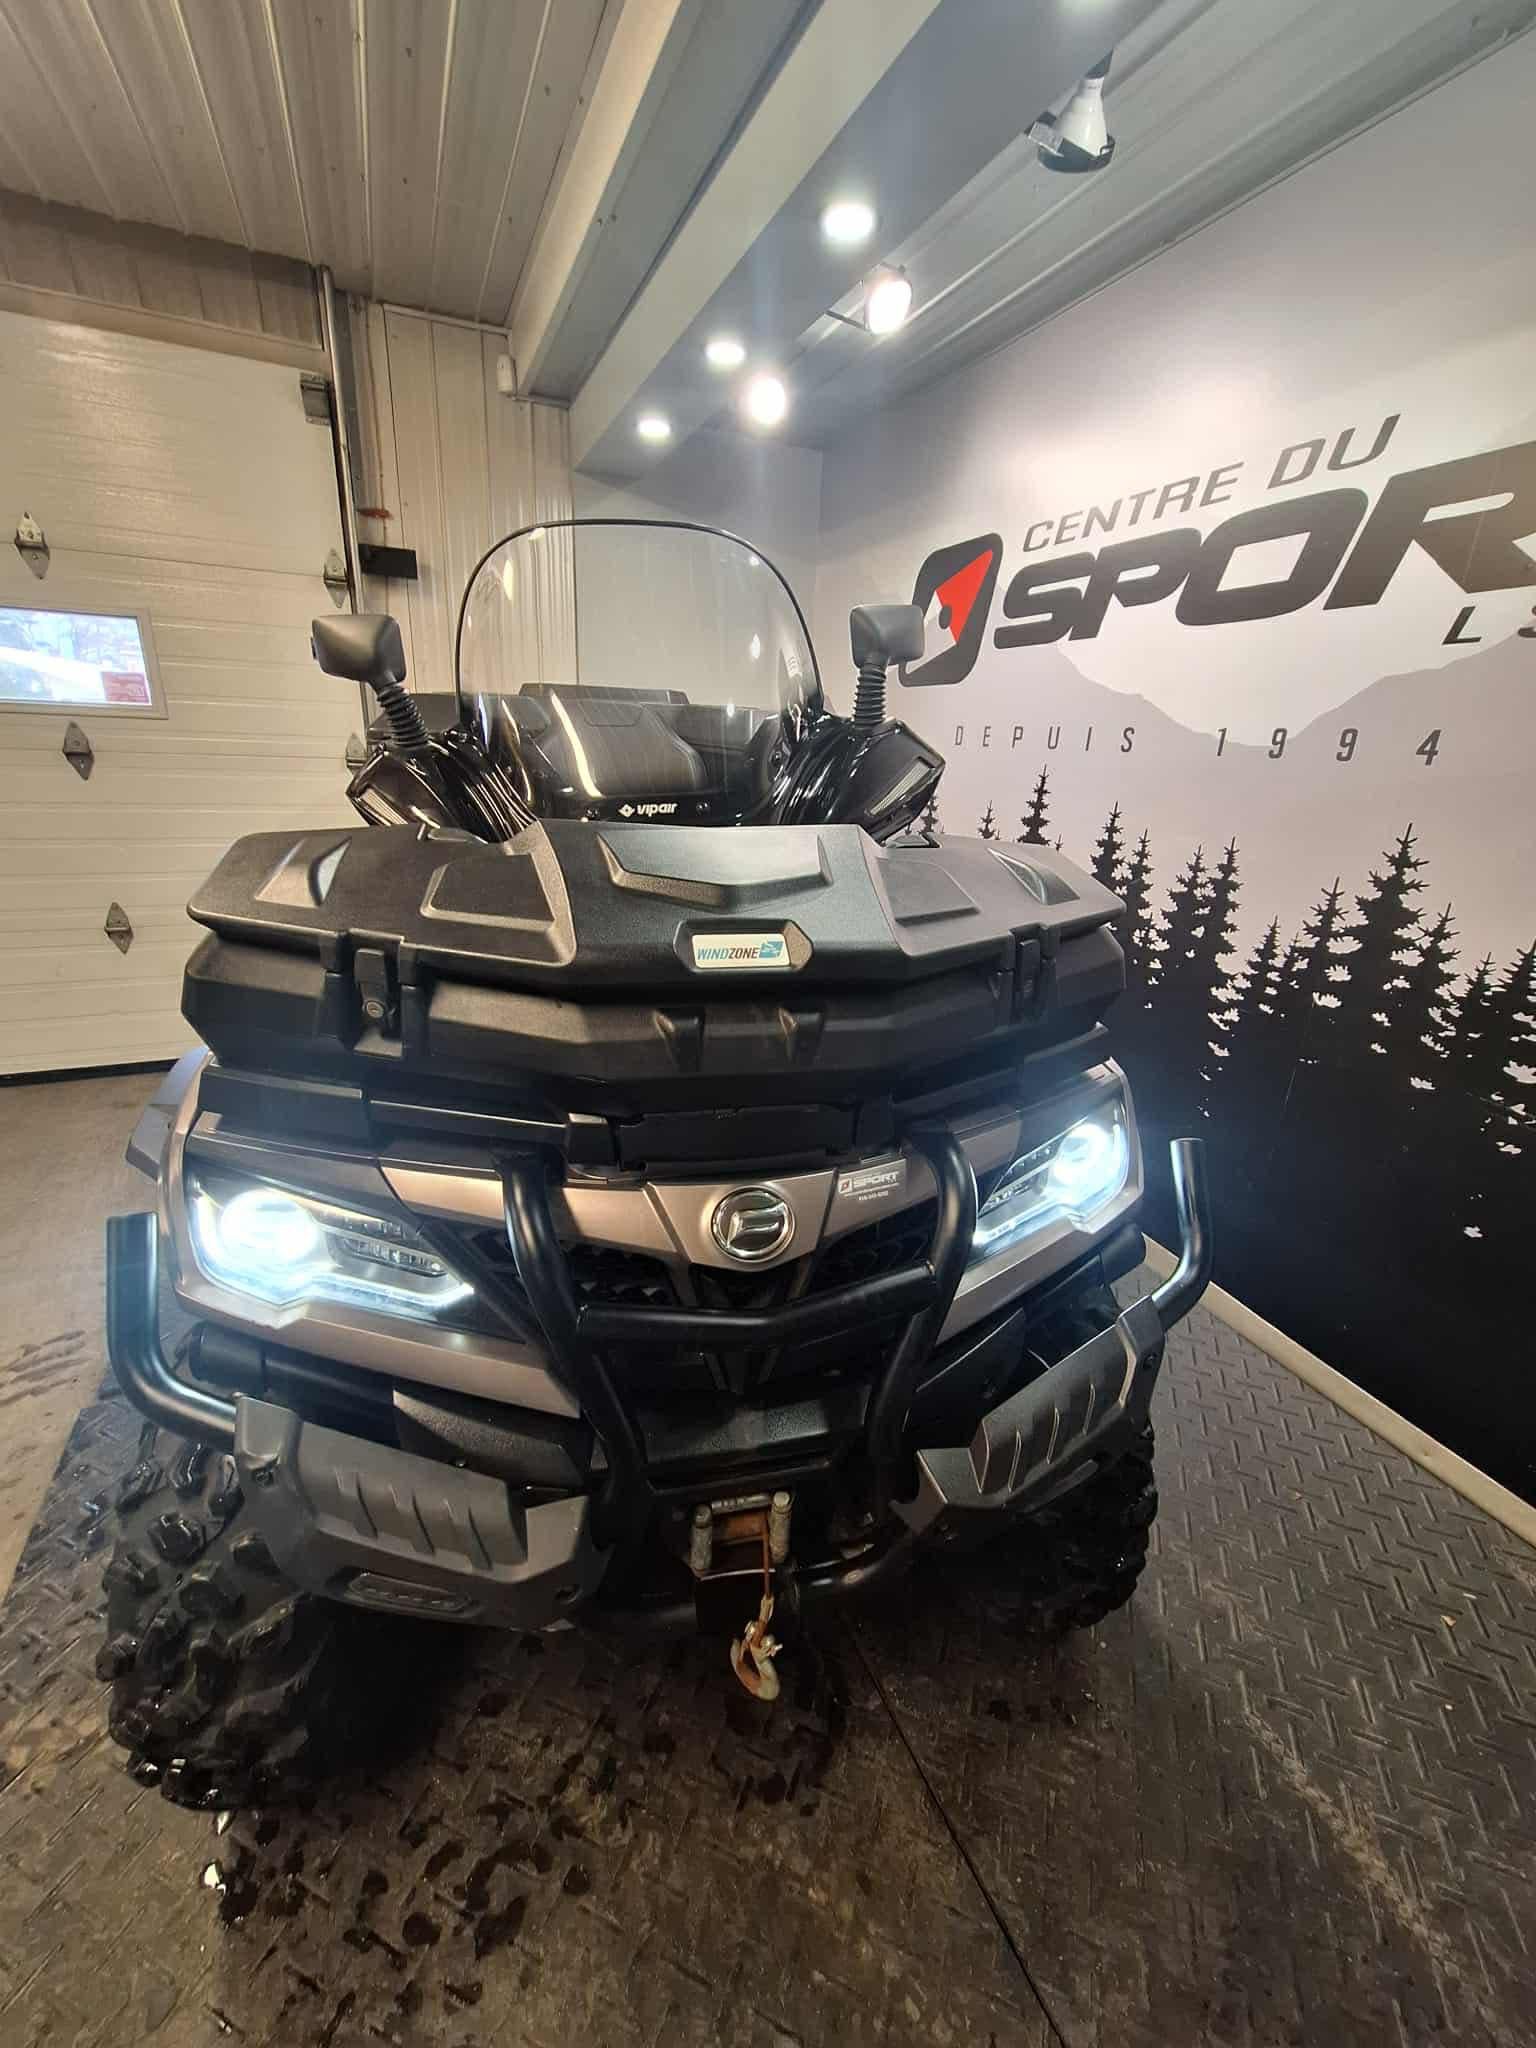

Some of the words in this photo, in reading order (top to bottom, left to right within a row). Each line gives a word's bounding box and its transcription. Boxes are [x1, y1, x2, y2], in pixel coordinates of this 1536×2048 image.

[1021, 461, 1245, 552] CENTRE
[1266, 413, 1401, 489] DU
[954, 725, 1136, 754] DEPUIS
[1215, 727, 1442, 767] 1994
[636, 803, 678, 817] vipair
[697, 947, 760, 960] WINDZONE
